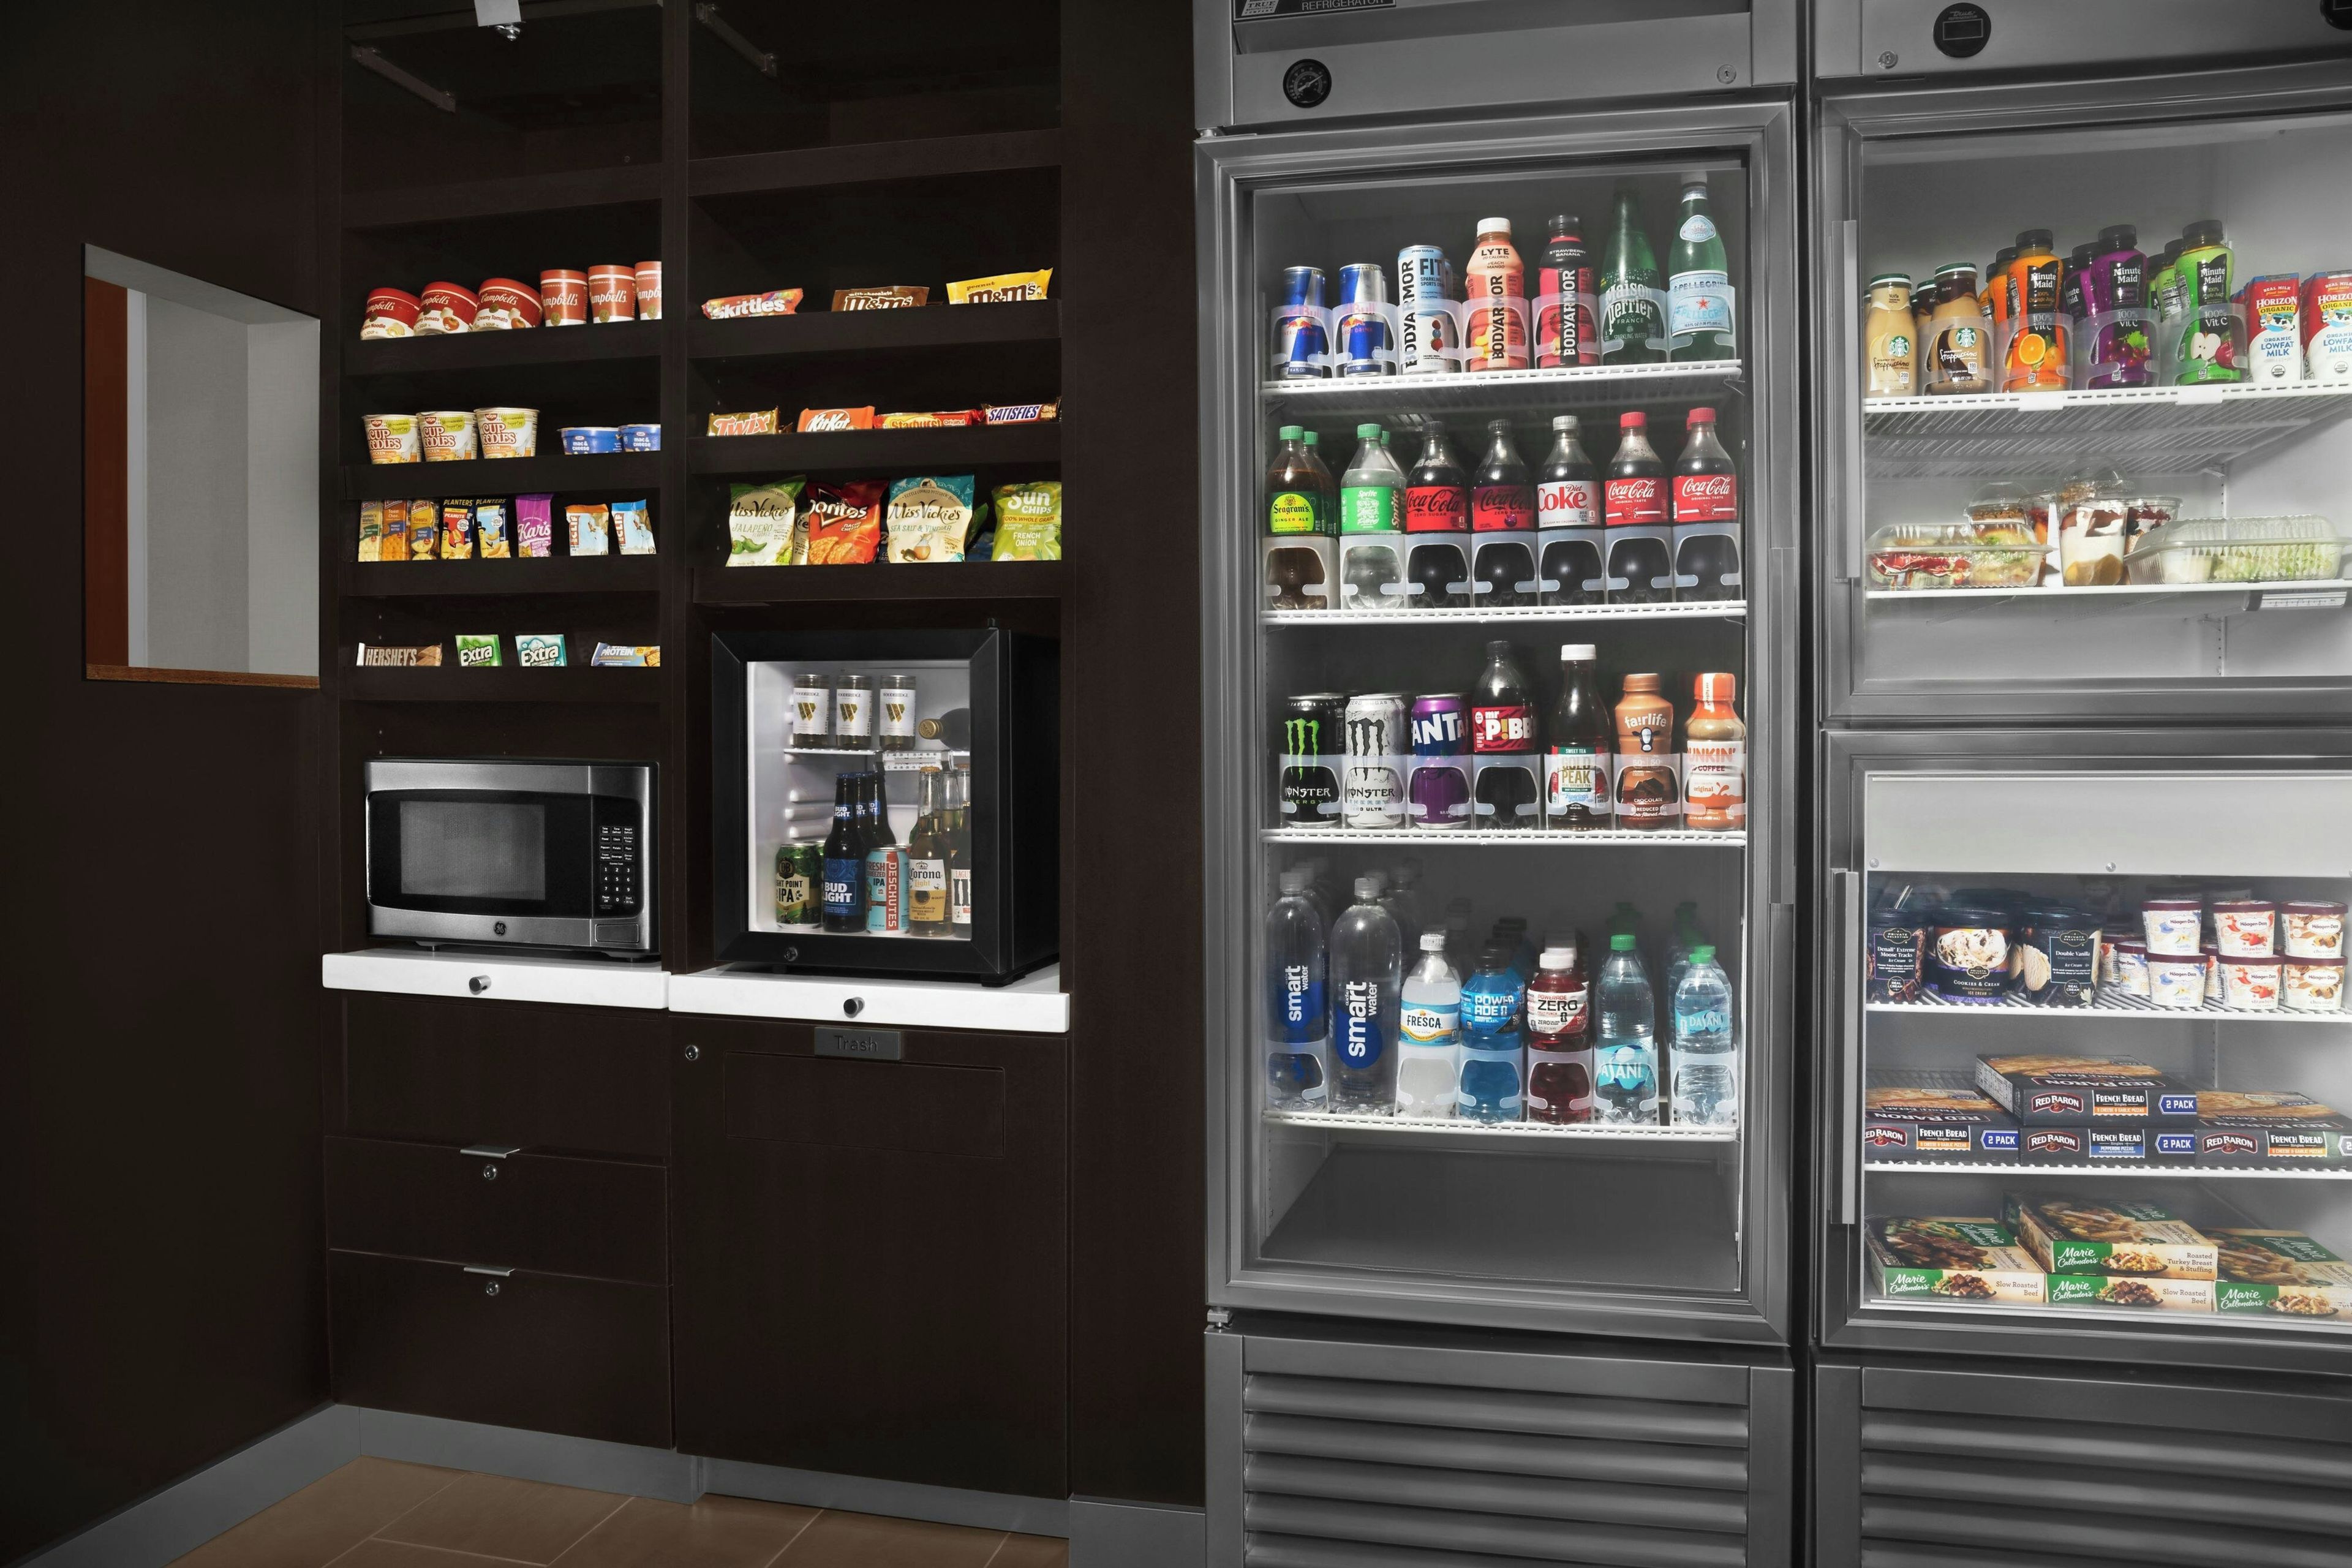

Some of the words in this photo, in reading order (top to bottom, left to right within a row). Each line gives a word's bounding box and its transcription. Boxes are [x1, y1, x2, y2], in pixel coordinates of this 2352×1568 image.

[1420, 258, 1442, 276] FIT
[2114, 266, 2141, 277] Minute
[2200, 267, 2225, 277] Minute
[2031, 273, 2056, 282] Minute
[2034, 279, 2052, 288] Maid
[967, 282, 995, 291] peanut
[1606, 281, 1652, 304] Maison
[481, 293, 517, 305] Campbell's
[2256, 296, 2297, 309] HORIZON
[712, 298, 785, 319] Skittles
[1562, 270, 1576, 356] BODYARMOR
[491, 315, 508, 323] Tomato
[1491, 275, 1504, 360] BODYARMOR
[2205, 318, 2220, 328] Vit
[2220, 317, 2228, 326] C
[2261, 341, 2294, 350] LOWFAT
[1940, 349, 1977, 362] frappuccino
[2266, 348, 2290, 357] MILK
[1874, 358, 1909, 370] frappuccino
[989, 405, 1041, 421] SATISFIES
[369, 429, 390, 439] CUP
[424, 426, 445, 437] CUP
[483, 423, 506, 434] CUP
[1608, 480, 1656, 500] Coca-Cola
[1682, 477, 1732, 496] Coca-Cola
[1008, 491, 1050, 509] Sun
[1539, 486, 1588, 512] Coke
[753, 498, 790, 521] Vickie's
[889, 502, 920, 521] Miss
[919, 499, 962, 525] Vickie's
[1022, 505, 1052, 514] CHIPS
[1273, 504, 1310, 516] Seagram's
[518, 521, 551, 541] Kar's
[365, 648, 418, 666] HERSHEY'S
[461, 645, 492, 665] Extra
[521, 645, 559, 665] Extra
[1485, 710, 1499, 719] mr
[1411, 712, 1468, 746] ANTA
[1562, 771, 1592, 784] PEAK
[909, 868, 941, 880] Corona
[824, 881, 848, 892] BUD
[873, 878, 885, 886] IPA
[778, 889, 794, 903] IPA
[888, 862, 897, 927] DESCHUTES
[1285, 965, 1302, 1022] smart
[1368, 982, 1378, 1016] water
[1475, 995, 1514, 1006] POWER
[1537, 1000, 1578, 1011] ZERO
[1474, 1005, 1498, 1016] ADE
[1346, 981, 1367, 1058] smart
[1407, 1014, 1441, 1029] FRESCA
[834, 1034, 878, 1053] Trash
[2035, 1097, 2050, 1107] RED
[2052, 1095, 2079, 1107] BARON
[2096, 1094, 2121, 1102] FRENCH
[2122, 1094, 2144, 1102] BREAD
[2173, 1100, 2194, 1109] PACK
[1875, 1129, 1903, 1141] BARON
[1920, 1128, 1944, 1137] FRENCH
[1945, 1128, 1967, 1138] BREAD
[2271, 1134, 2299, 1144] FRENCH
[1988, 1135, 1994, 1144] 2
[1995, 1135, 2015, 1144] PACK
[2031, 1136, 2047, 1146] RED
[2048, 1134, 2076, 1147] BARON
[2170, 1140, 2191, 1148] PACK
[2206, 1138, 2222, 1147] RED
[2223, 1136, 2253, 1148] BARON
[2059, 1247, 2095, 1259] Marie
[2057, 1257, 2099, 1267] Callender's
[1891, 1274, 1926, 1285] Marie
[1890, 1283, 1929, 1294] Callender's
[2054, 1281, 2090, 1292] Marie
[2052, 1291, 2094, 1302] Callender's
[2222, 1289, 2261, 1300] Marie
[2221, 1299, 2264, 1310] Callender's
